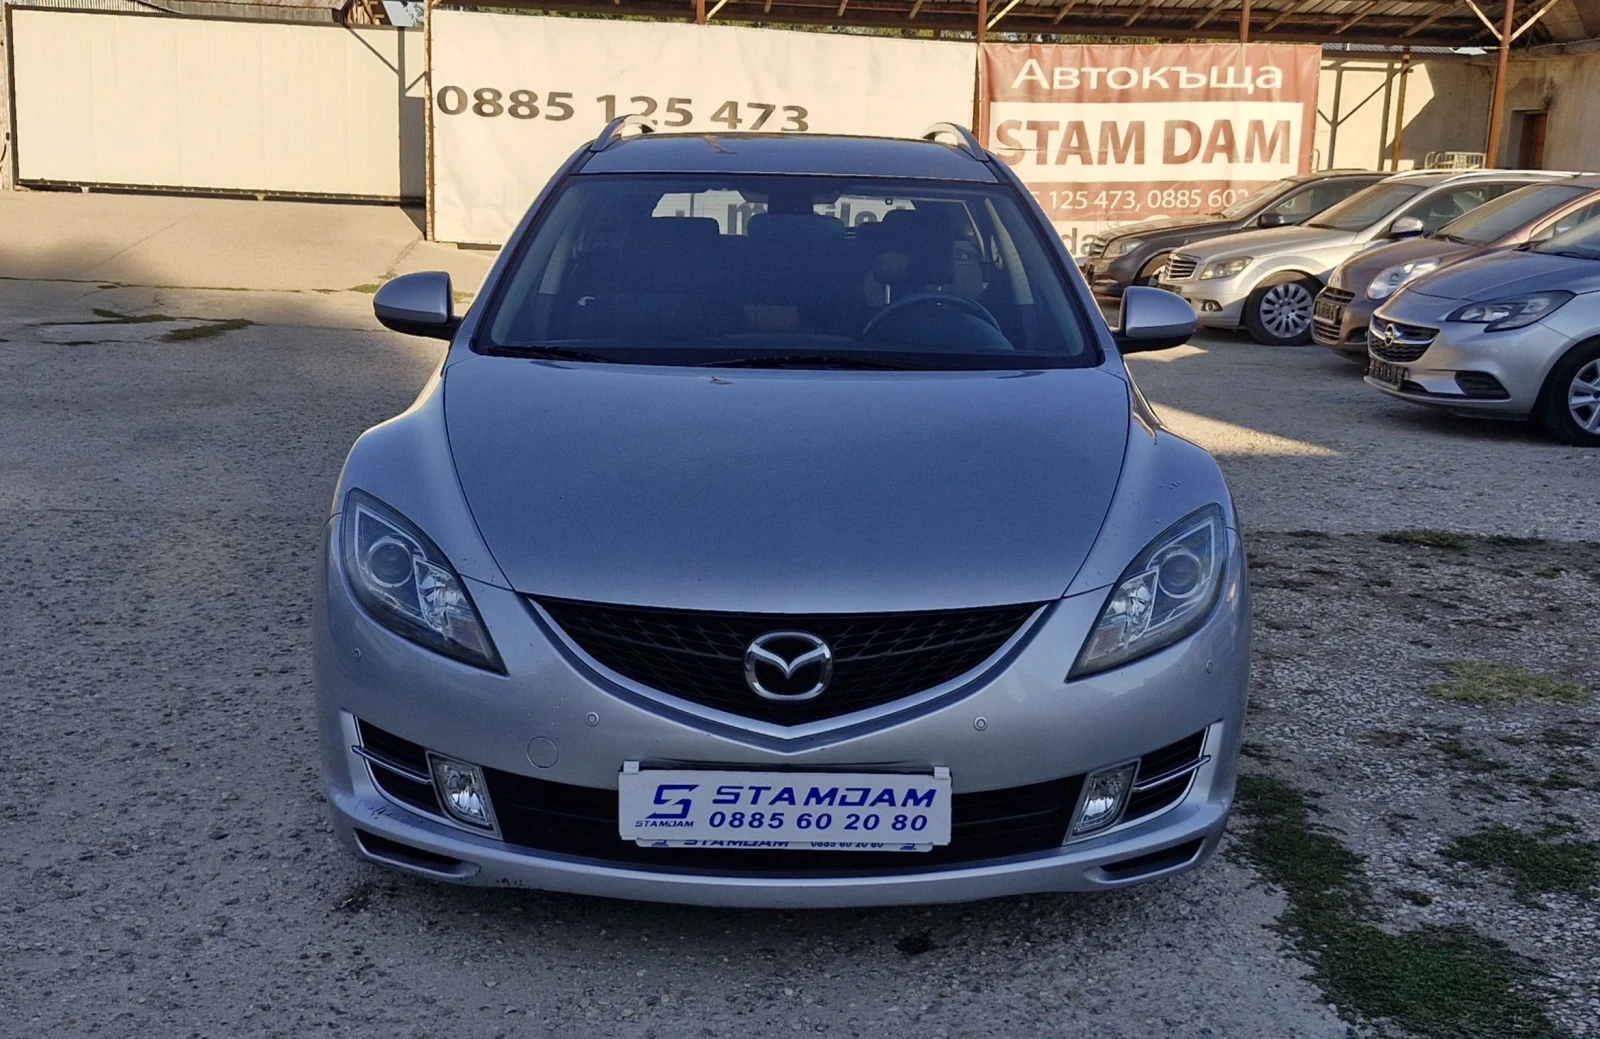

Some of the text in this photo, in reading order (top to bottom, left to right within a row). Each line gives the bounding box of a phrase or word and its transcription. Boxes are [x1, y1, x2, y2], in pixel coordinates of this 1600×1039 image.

[1011, 58, 1283, 94] Автокъща
[436, 85, 809, 132] 0885 125 473
[996, 119, 1291, 166] STAM DAM
[1049, 190, 1088, 209] 125
[1094, 190, 1141, 212] 473,
[1147, 189, 1202, 208] 0885
[712, 785, 937, 808] STAMDAM
[708, 811, 928, 831] 0885 60 20 80
